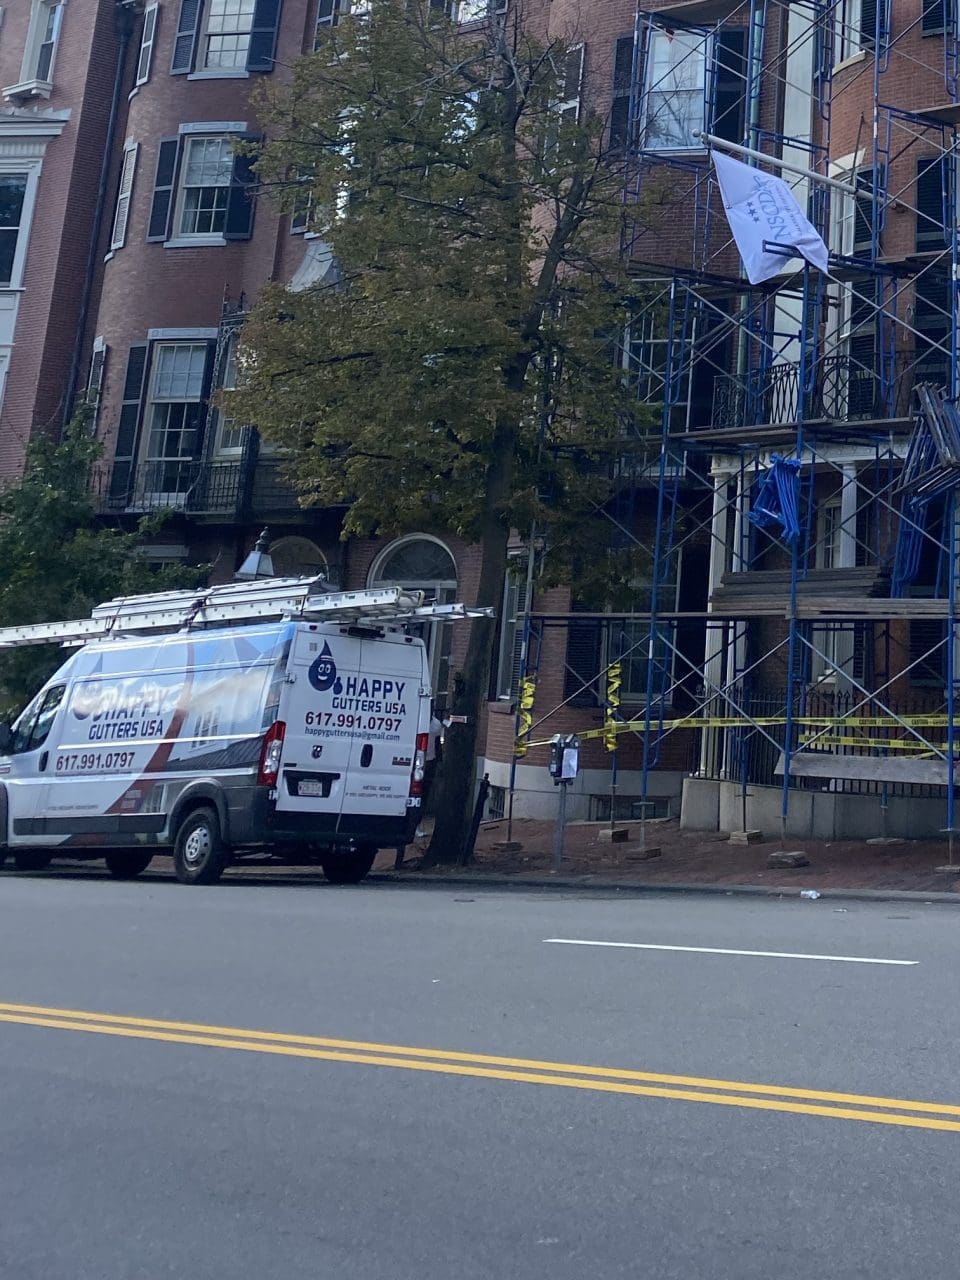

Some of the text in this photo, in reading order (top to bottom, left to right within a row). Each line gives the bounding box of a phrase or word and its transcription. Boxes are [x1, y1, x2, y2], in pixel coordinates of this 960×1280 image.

[346, 677, 406, 701] HAPPY
[332, 697, 406, 716] GUTTERS USA
[88, 719, 163, 740] GUTTERS USA
[305, 711, 402, 732] 617.991.0797
[304, 727, 400, 741] happyguttersusa@gmail.com
[56, 752, 135, 770] 617.991.0797
